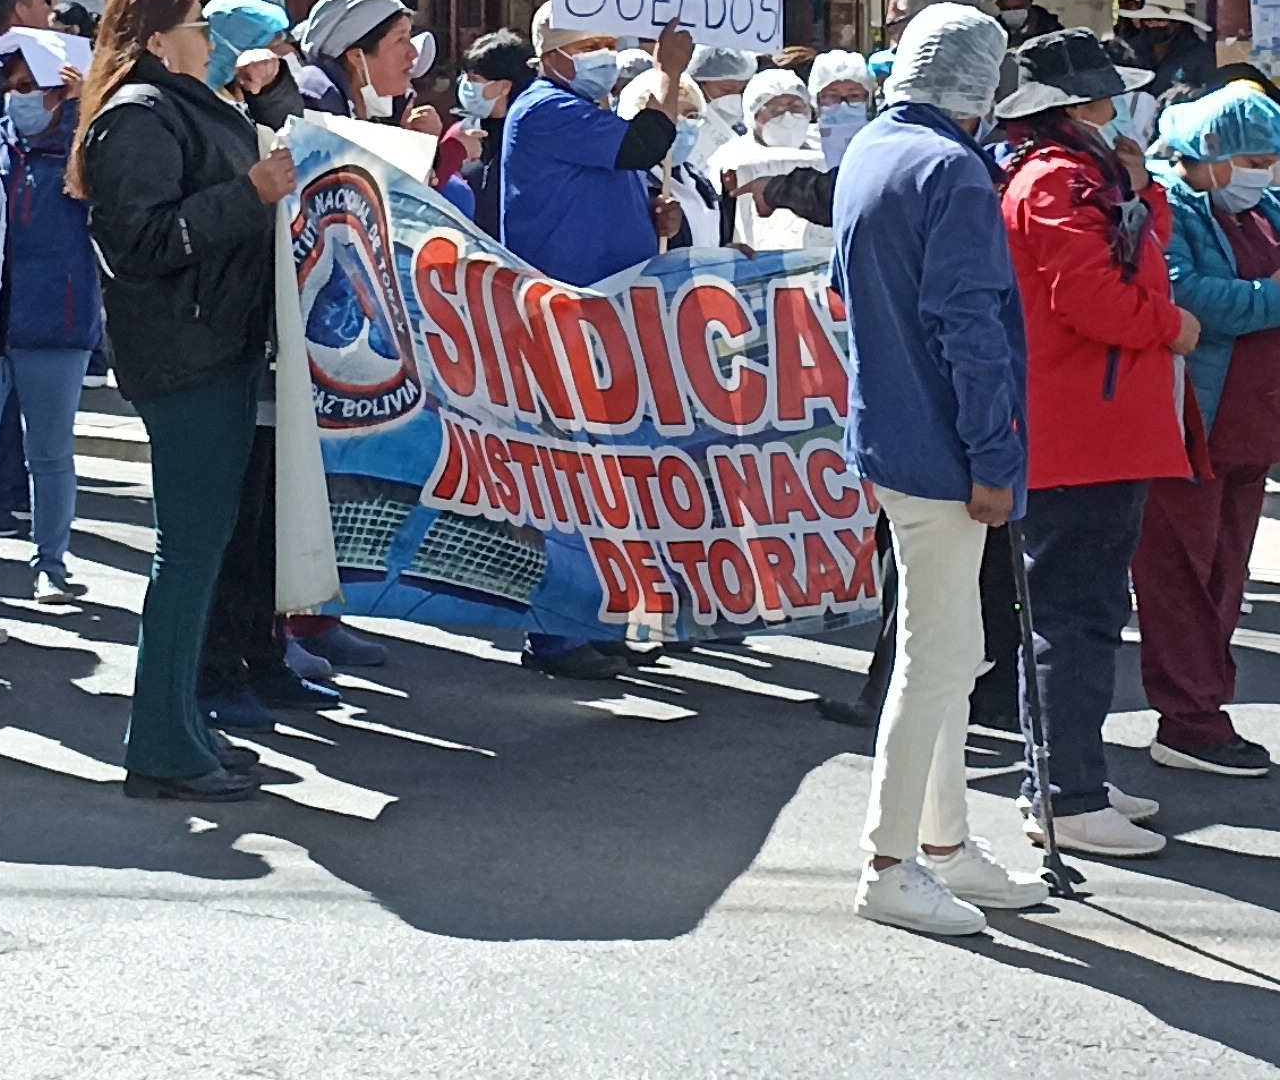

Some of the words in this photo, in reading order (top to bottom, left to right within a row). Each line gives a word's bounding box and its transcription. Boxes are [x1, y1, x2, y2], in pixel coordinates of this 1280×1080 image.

[339, 377, 420, 418] BOLIVIA
[432, 417, 705, 530] INSTITUTO
[589, 535, 676, 614] DE
[668, 526, 878, 616] TORAX
